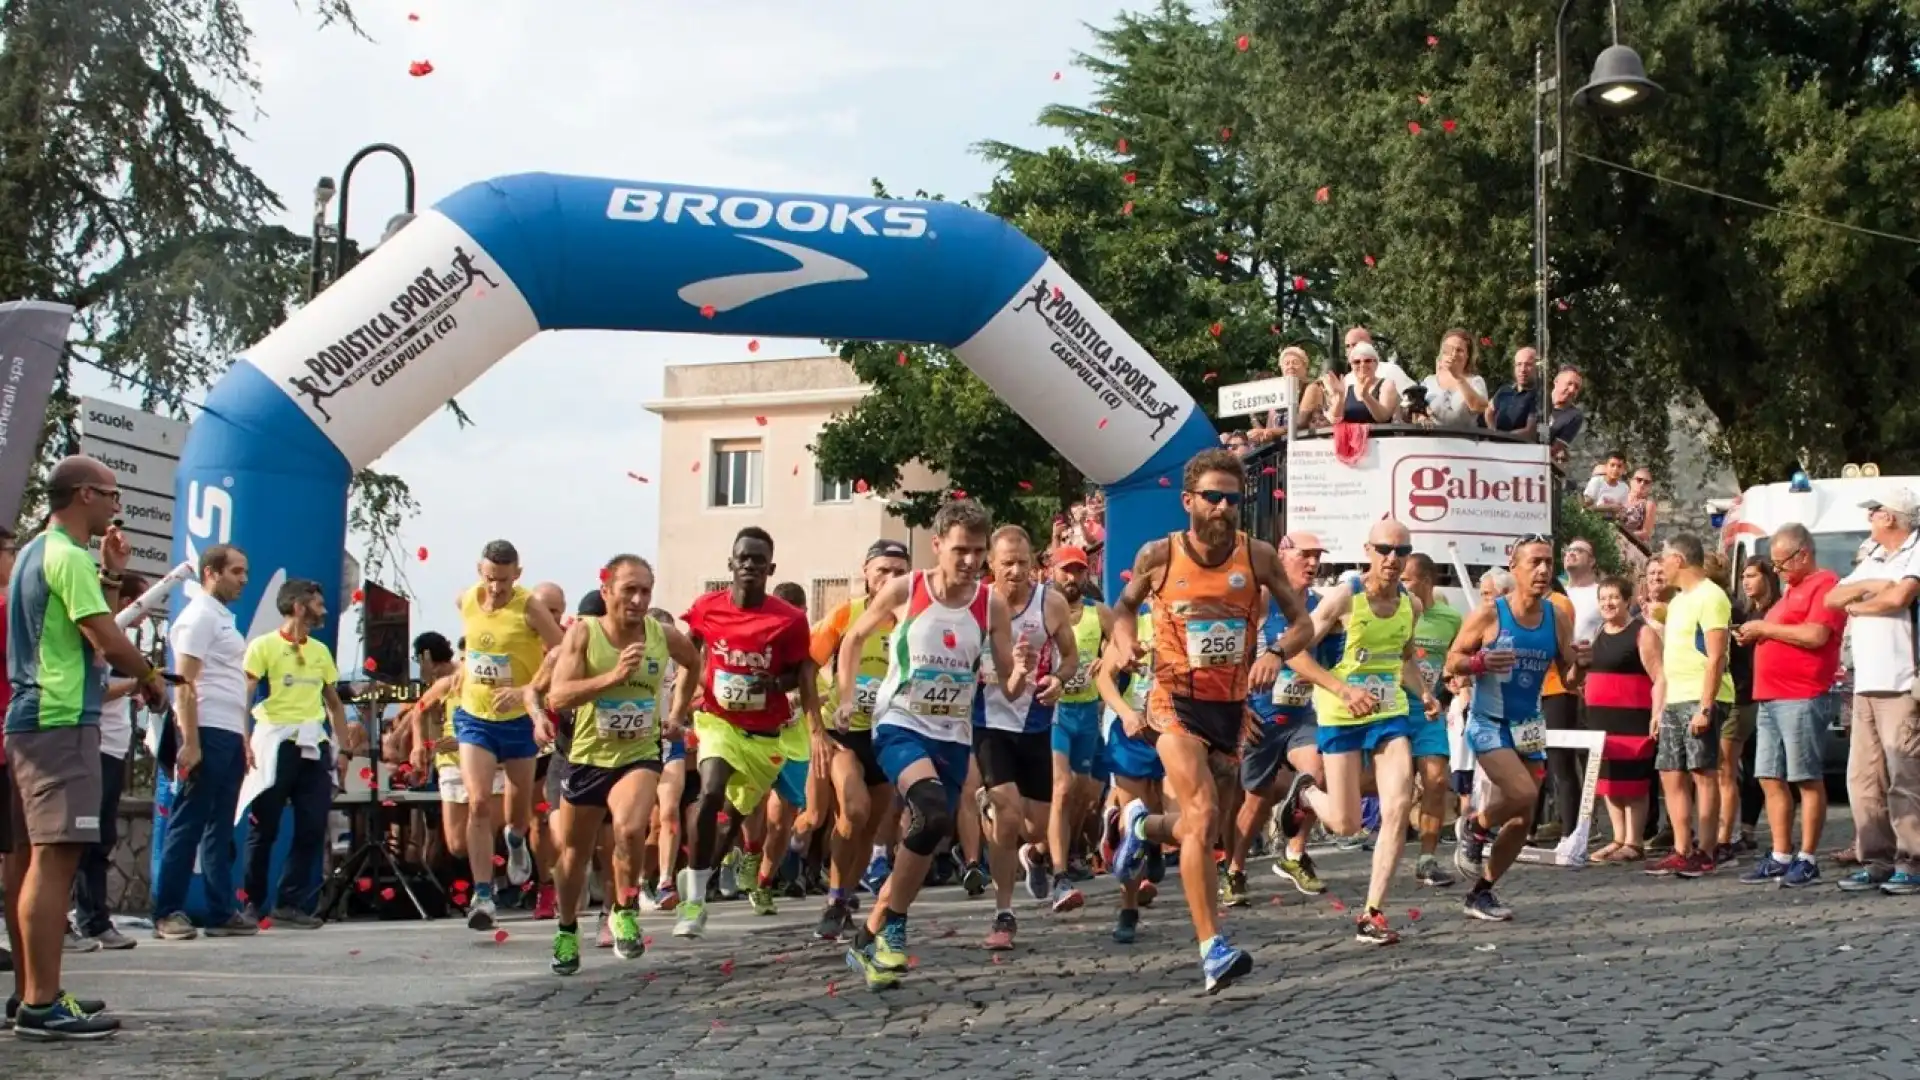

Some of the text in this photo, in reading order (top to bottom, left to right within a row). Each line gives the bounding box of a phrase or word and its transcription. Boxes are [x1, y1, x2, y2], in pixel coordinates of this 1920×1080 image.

[606, 187, 928, 238] BROOKS
[304, 312, 399, 386] PODISTICA
[390, 267, 446, 323] SPORT
[371, 333, 435, 387] CASAPULLA
[433, 314, 458, 339] (CE)
[1046, 290, 1114, 365] PODISTICA
[1108, 355, 1157, 400] SPORT
[1050, 341, 1104, 392] CASAPULLA
[1099, 389, 1124, 410] (CE)
[1232, 393, 1276, 410] CELESTINO
[89, 410, 134, 431] scuole
[1409, 466, 1548, 522] gabetti
[126, 502, 171, 522] sportivo
[1450, 507, 1548, 521] FRANCHISING AGENCY
[1201, 636, 1236, 654] 256
[474, 664, 498, 677] 441
[923, 687, 961, 702] 447
[610, 714, 644, 729] 276
